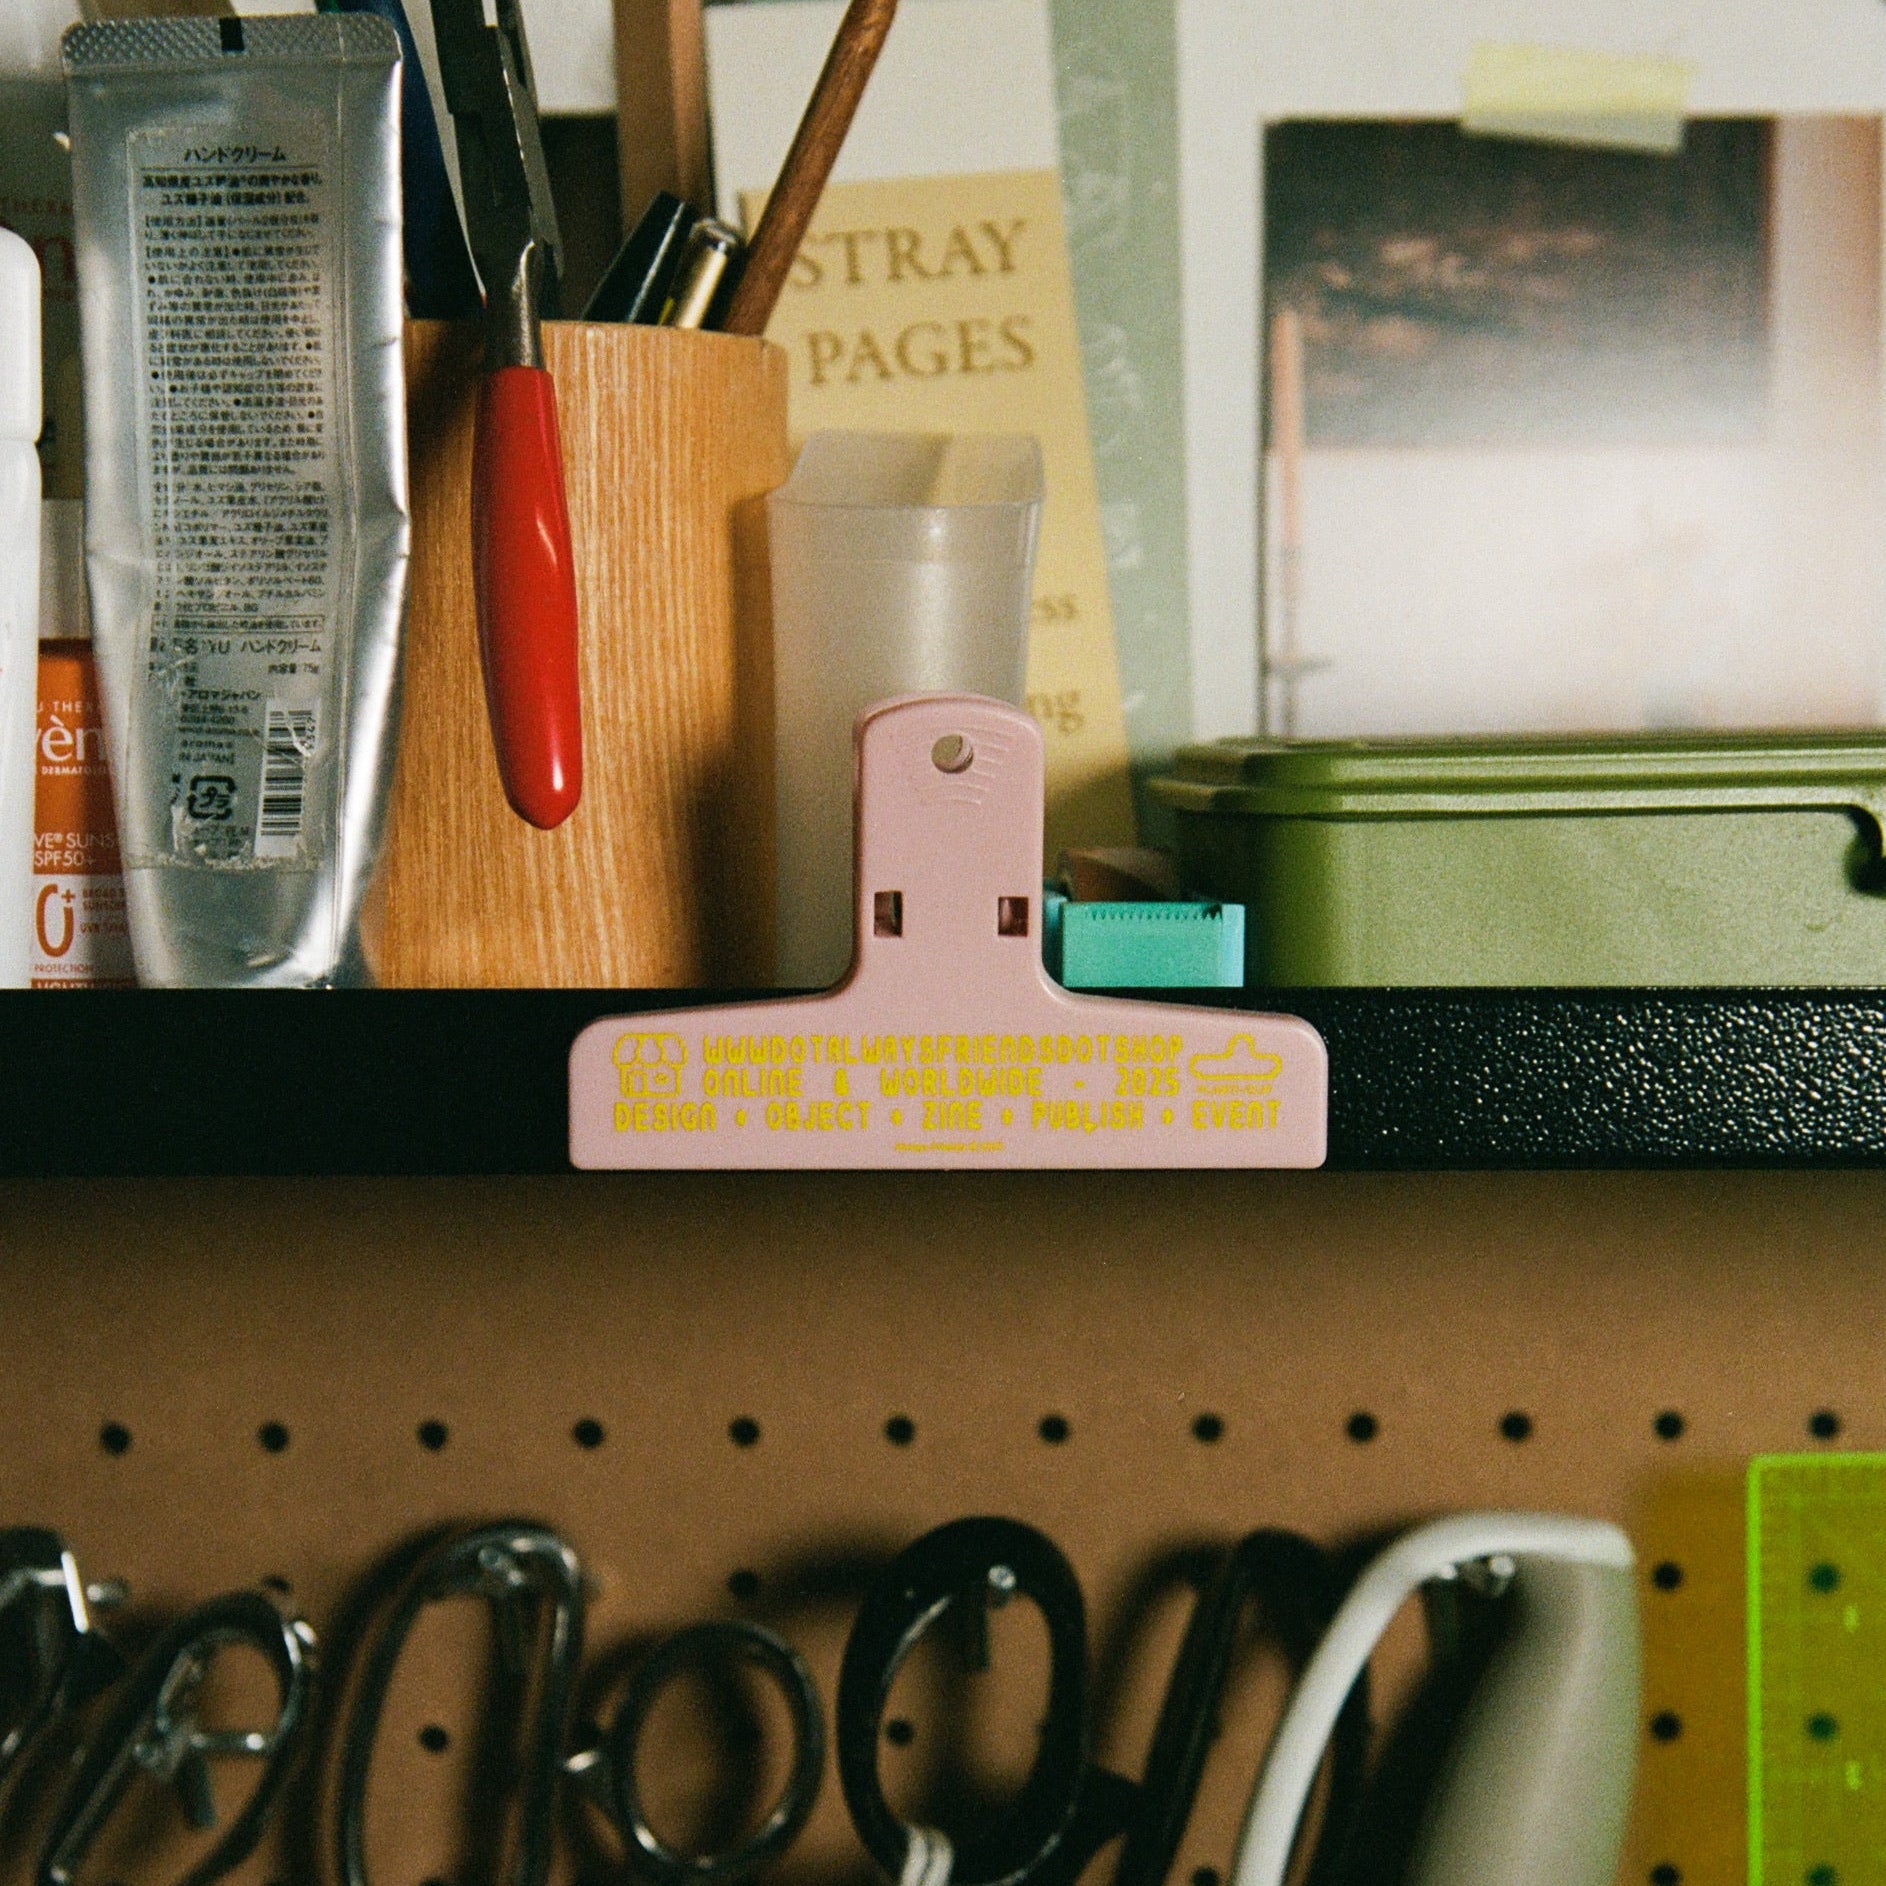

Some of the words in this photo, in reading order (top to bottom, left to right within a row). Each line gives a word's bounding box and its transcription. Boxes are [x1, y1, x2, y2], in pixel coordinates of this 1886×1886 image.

[184, 146, 286, 163] ハンドクリーム
[790, 217, 1027, 288] STRAY
[806, 314, 1035, 386] PAGES
[702, 1067, 804, 1098] ONLINE
[879, 1067, 1043, 1098] WORLDWIDE
[1115, 1067, 1181, 1097] 2025
[613, 1101, 717, 1133] DESIGN
[764, 1100, 872, 1132] OBJECT
[921, 1100, 983, 1131] ZINE
[1031, 1099, 1144, 1135] PUBLISH
[1191, 1099, 1281, 1131] EVENT
